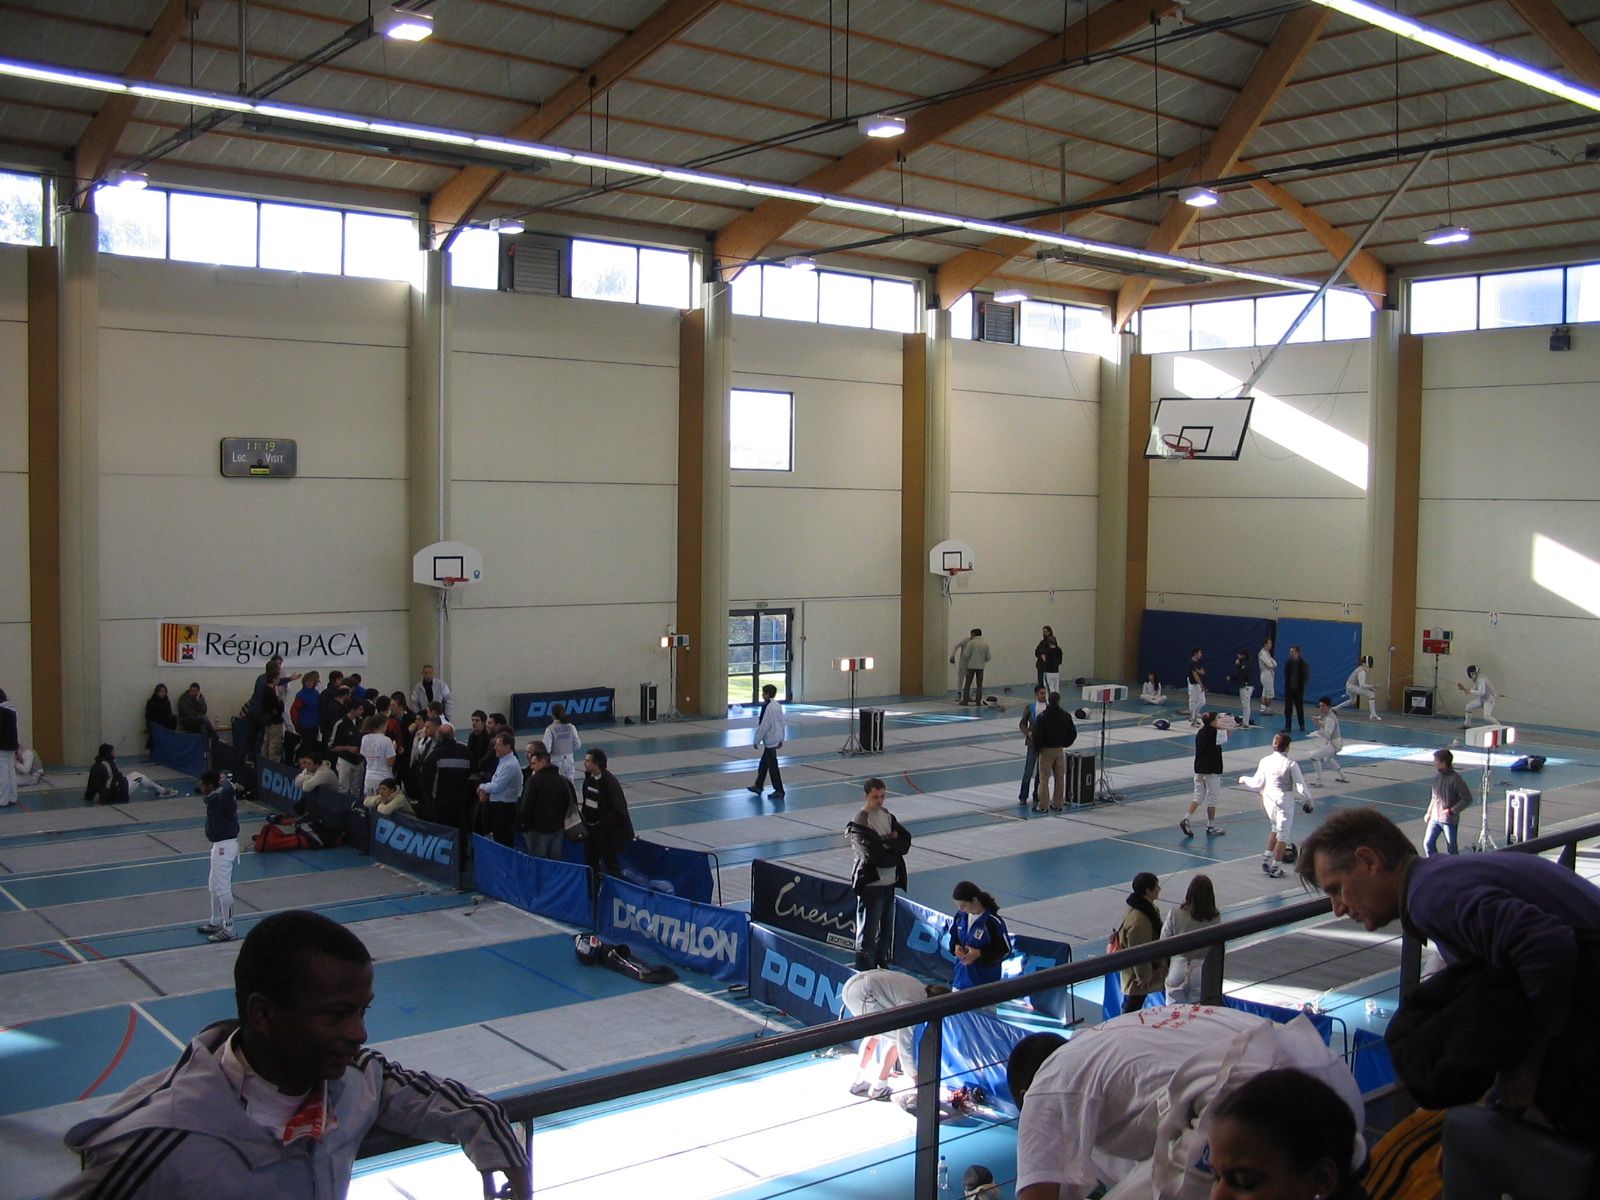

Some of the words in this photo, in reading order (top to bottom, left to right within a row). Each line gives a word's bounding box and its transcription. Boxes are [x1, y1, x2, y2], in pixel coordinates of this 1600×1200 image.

[206, 632, 289, 665] Région
[297, 632, 364, 656] PACA
[527, 696, 610, 718] DONIC
[262, 768, 304, 800] DONI
[375, 817, 454, 864] DONIC
[613, 898, 738, 963] DECATHLON
[761, 948, 855, 1019] DON
